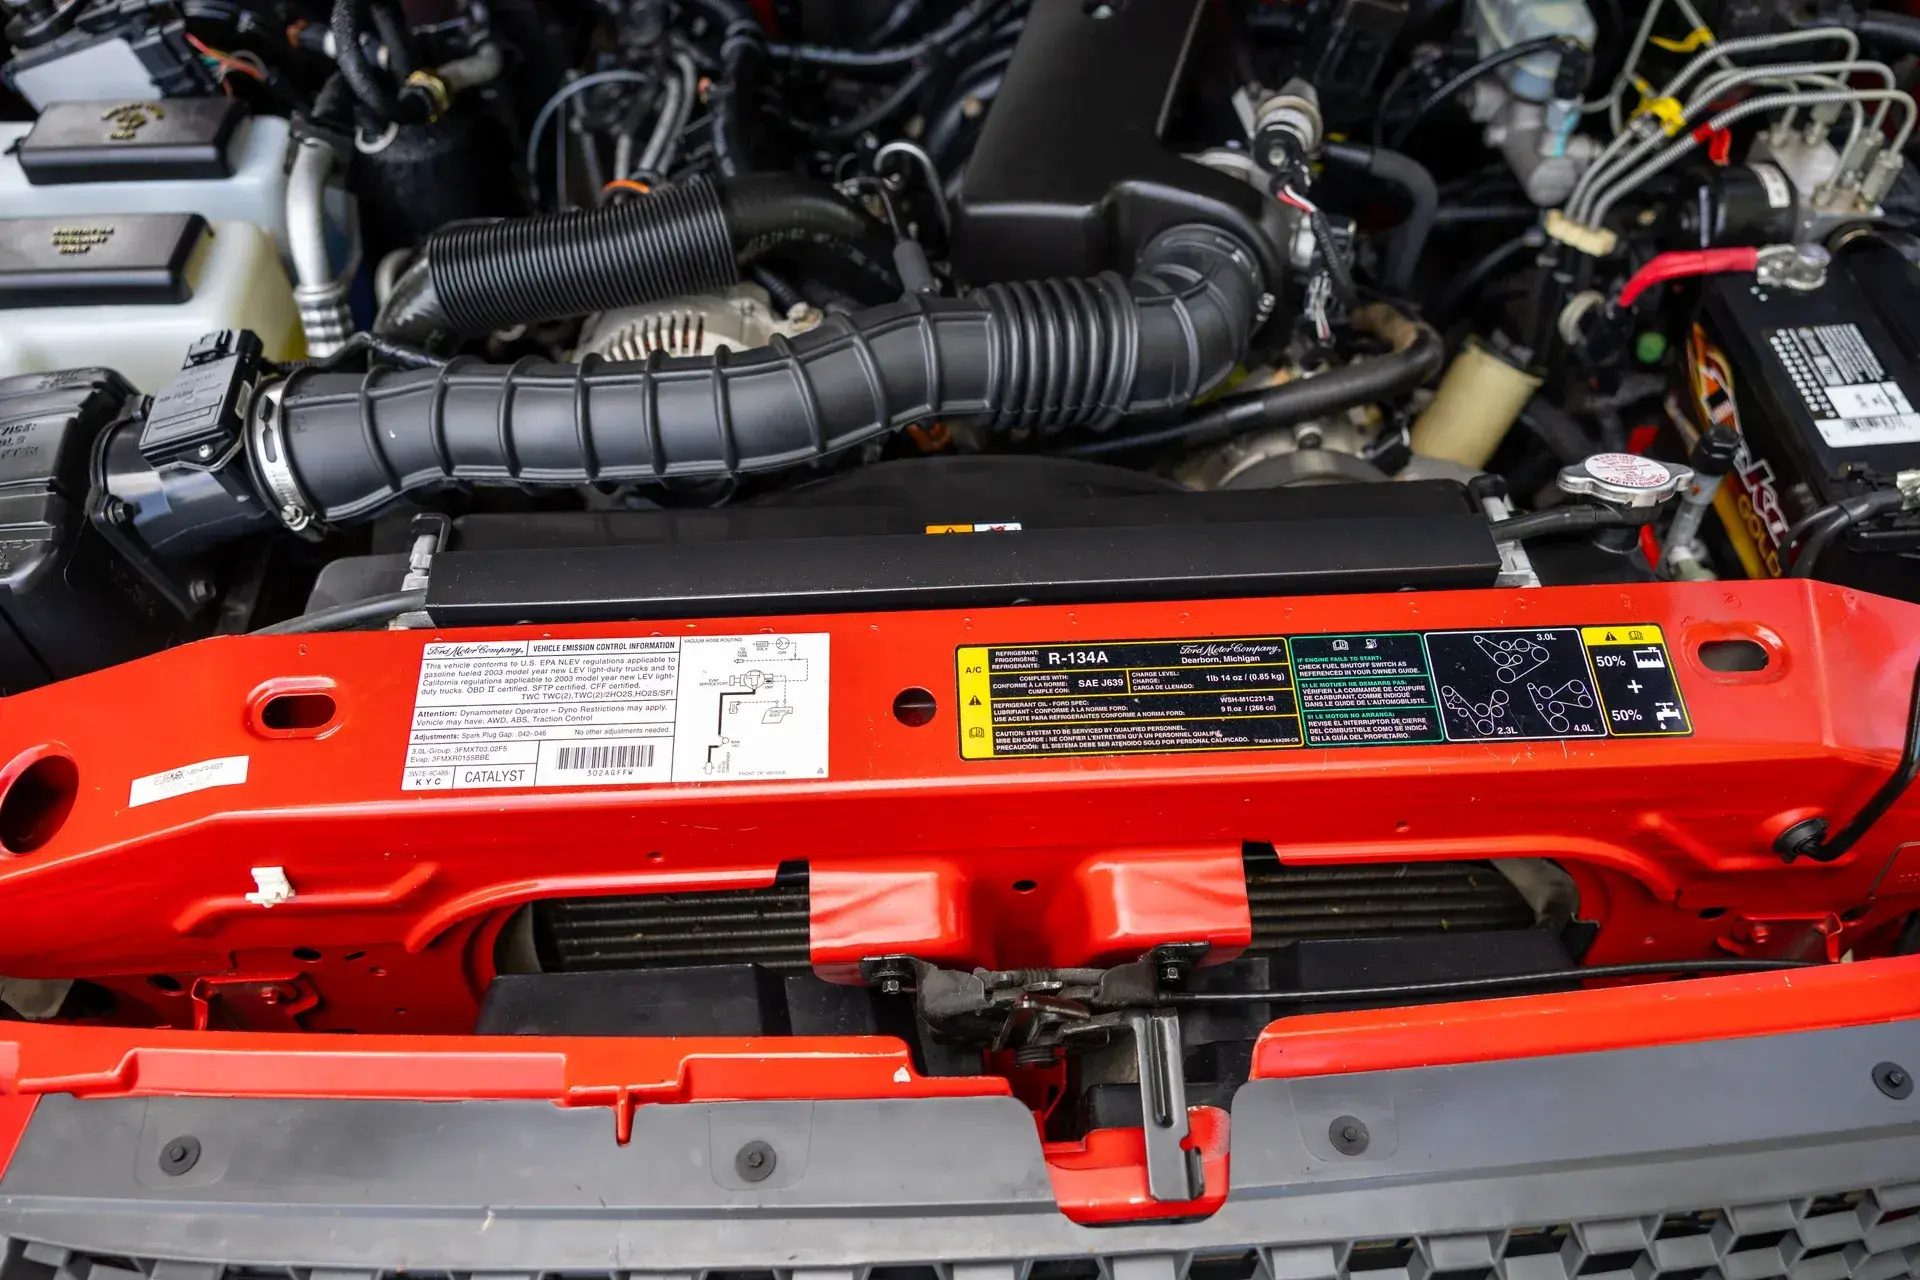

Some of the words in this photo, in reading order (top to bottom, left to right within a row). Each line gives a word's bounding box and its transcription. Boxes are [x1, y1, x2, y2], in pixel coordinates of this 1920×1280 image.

[1738, 493, 1782, 577] GOLD
[1537, 633, 1556, 641] 3.0L
[596, 643, 627, 651] CONTROL
[629, 642, 675, 650] INFORMATION
[1180, 645, 1203, 654] Ford
[1201, 645, 1232, 655] Motor
[427, 646, 449, 656] Ford
[446, 646, 477, 657] Motor
[1048, 651, 1109, 665] R-134A
[1182, 656, 1222, 664] Dearborn,
[1223, 655, 1260, 663] Michigan
[1596, 655, 1627, 667] 50%
[473, 661, 508, 669] conforms
[583, 658, 624, 666] regulations
[627, 657, 666, 665] applicable
[424, 671, 455, 679] gasoline
[587, 666, 623, 675] light-duty
[965, 666, 982, 674] A/C
[461, 678, 501, 686] regulations
[505, 677, 542, 685] applicable
[1205, 674, 1218, 682] 1lb
[1249, 673, 1269, 681] (0.85
[1271, 672, 1285, 681] kg)
[1078, 679, 1099, 687] SAE
[1101, 678, 1123, 687] J639
[460, 709, 512, 717] Dynamometer
[1611, 709, 1642, 721] 50%
[1498, 726, 1517, 735] 2.3L
[1574, 724, 1594, 732] 4.0L
[462, 732, 480, 740] Spark
[465, 770, 525, 783] CATALYST
